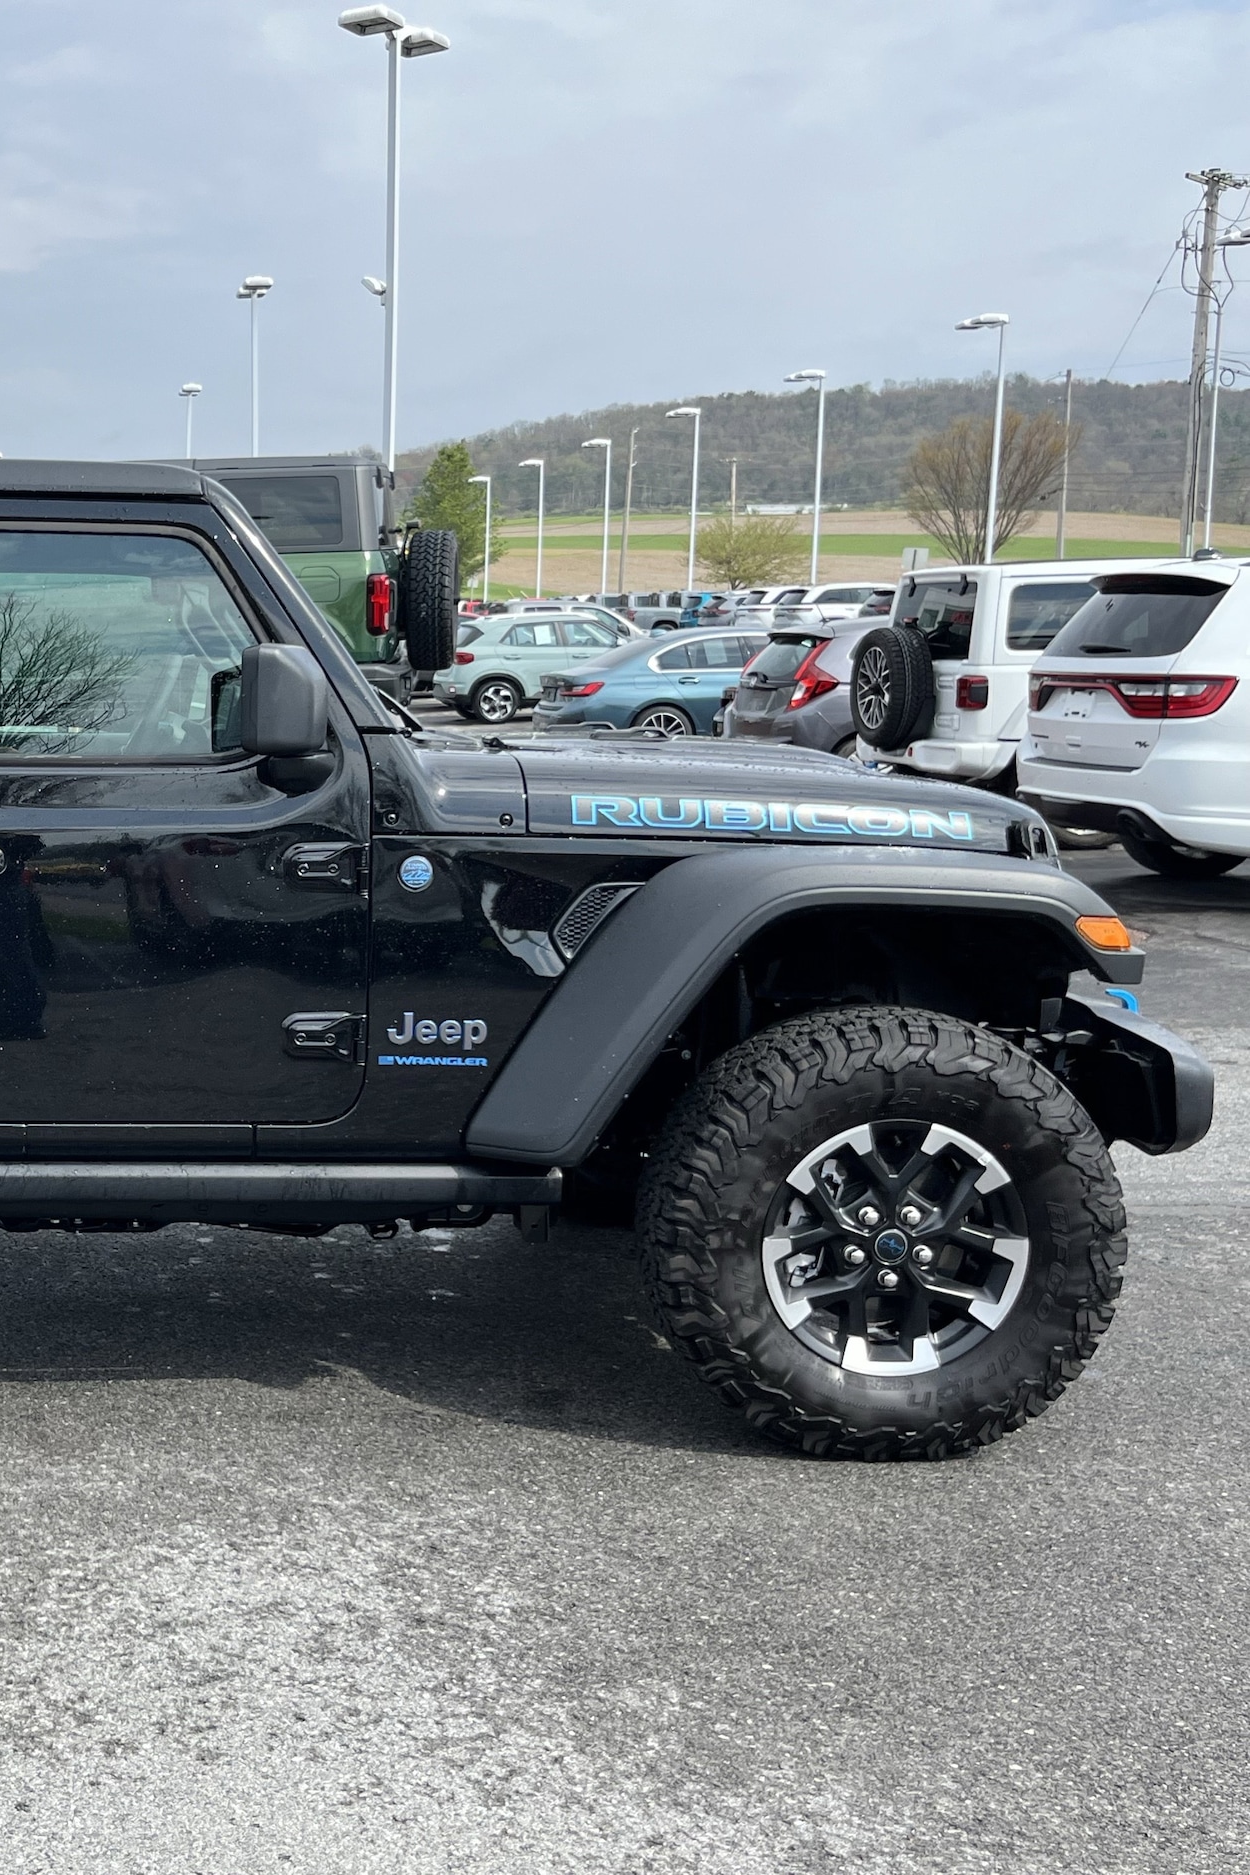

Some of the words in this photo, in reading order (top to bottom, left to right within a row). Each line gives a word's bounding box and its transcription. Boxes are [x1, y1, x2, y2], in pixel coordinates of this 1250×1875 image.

[571, 795, 973, 840] RUBICON
[386, 1011, 488, 1051] Jeep
[394, 1056, 488, 1066] WRANGLER
